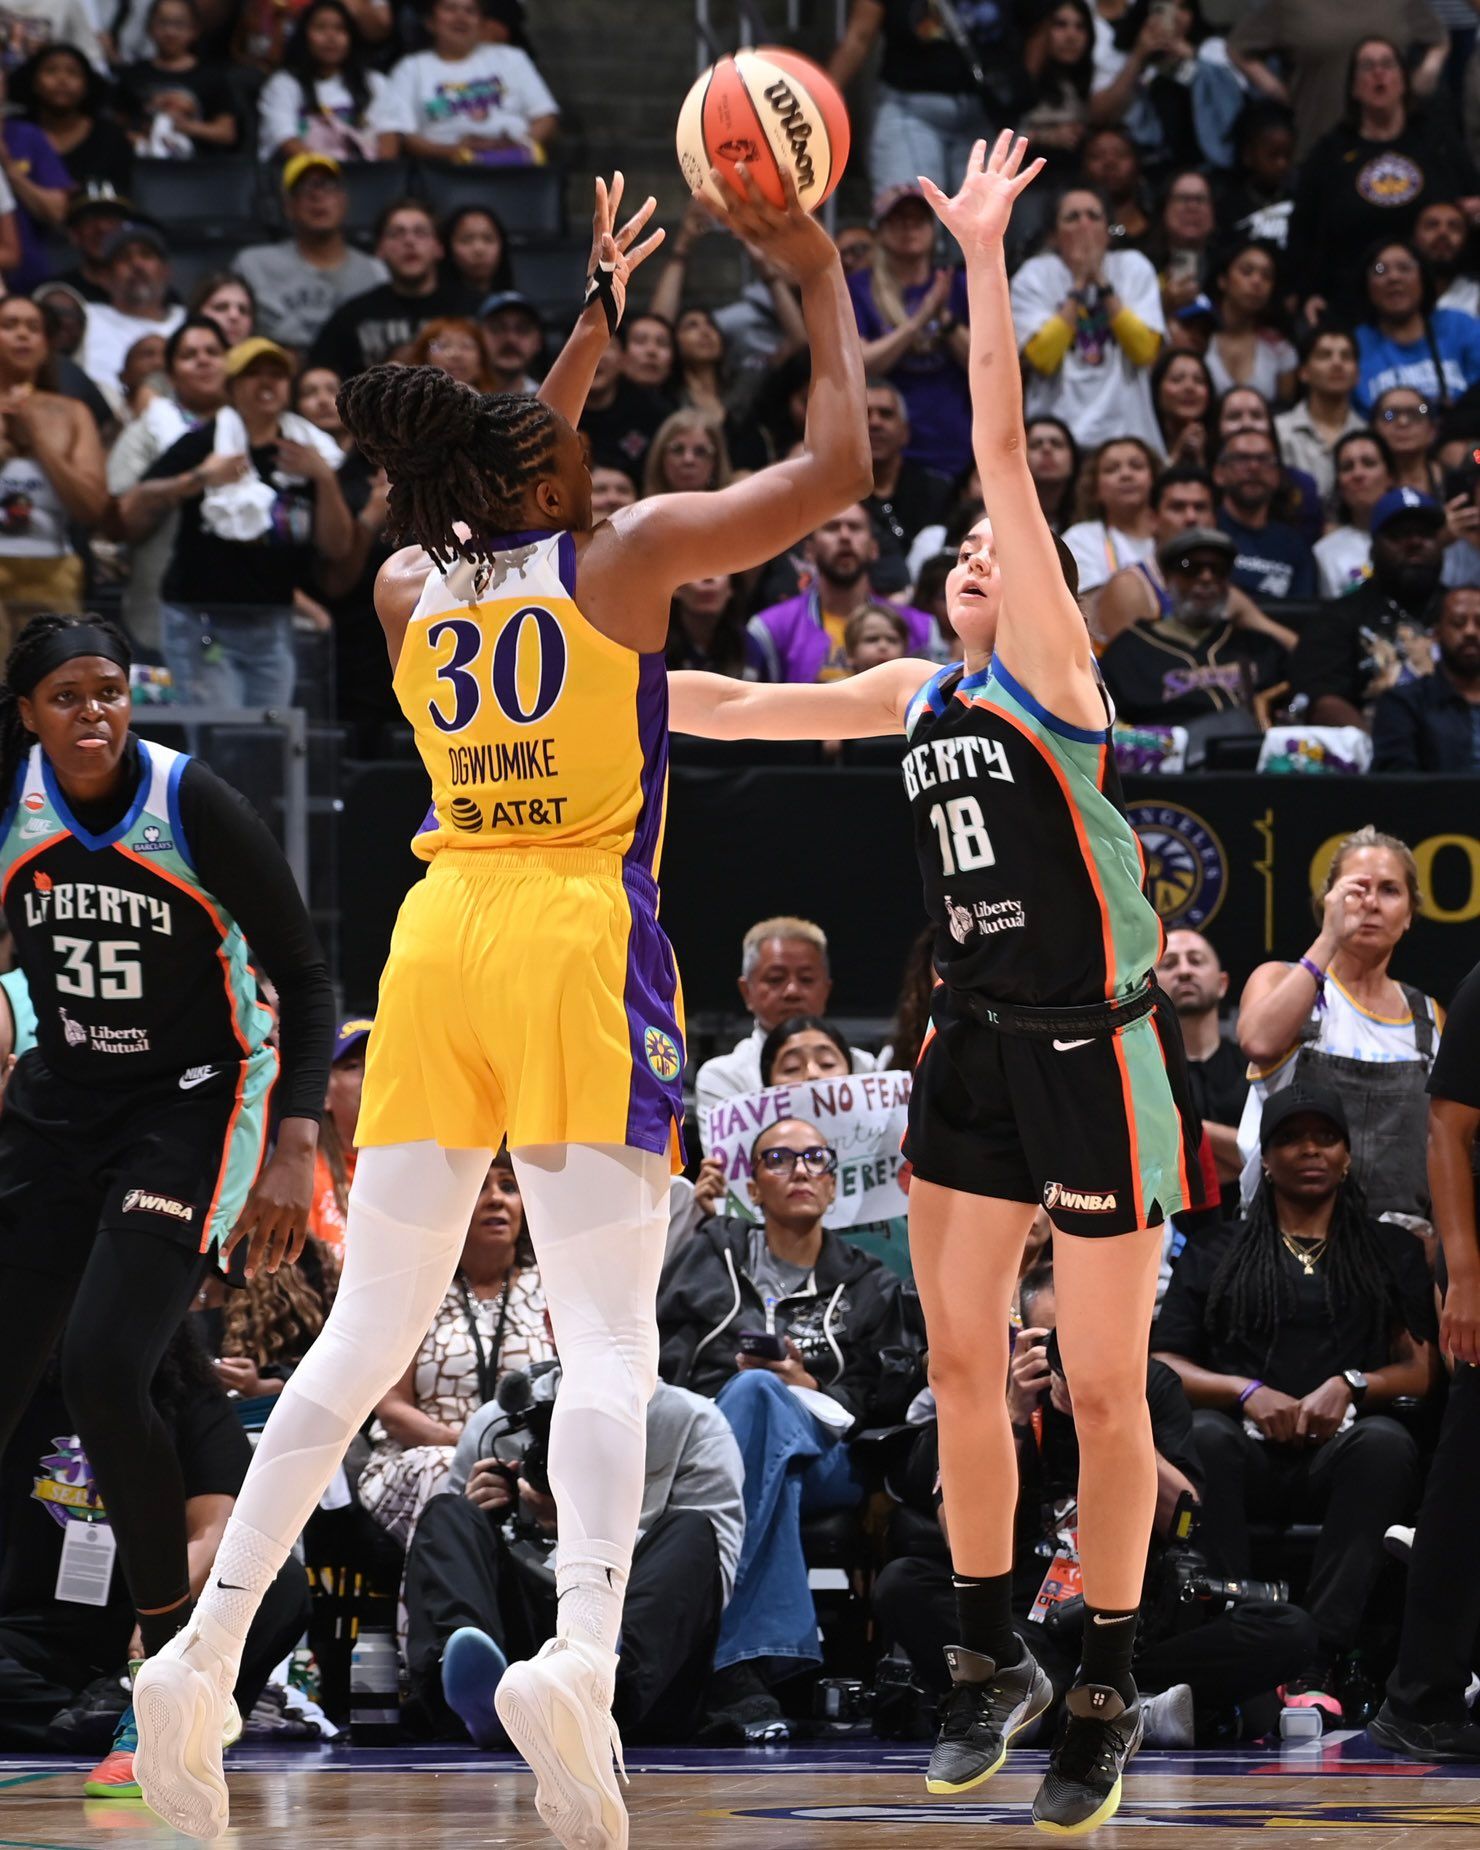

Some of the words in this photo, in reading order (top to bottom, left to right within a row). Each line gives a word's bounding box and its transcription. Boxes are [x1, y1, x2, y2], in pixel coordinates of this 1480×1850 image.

[764, 79, 816, 194] Wilson
[427, 606, 567, 734] 30
[448, 738, 559, 786] OGWUMIKE
[901, 735, 1015, 802] BERTY
[491, 797, 568, 828] AT&T
[134, 841, 173, 852] BARCLAYS
[929, 795, 996, 877] 18
[24, 883, 173, 936] LIBERTY
[972, 900, 1022, 918] Liberty
[978, 910, 1026, 936] Mutual
[52, 935, 144, 1000] 35
[90, 1025, 148, 1040] Liberty
[91, 1038, 150, 1054] Mutual
[184, 1065, 213, 1080] NIKE
[710, 1091, 793, 1145] HAVE
[811, 1083, 855, 1118] NO
[841, 1155, 898, 1198] ERE!
[138, 1195, 193, 1221] WNBA
[1060, 1190, 1117, 1211] WNBA
